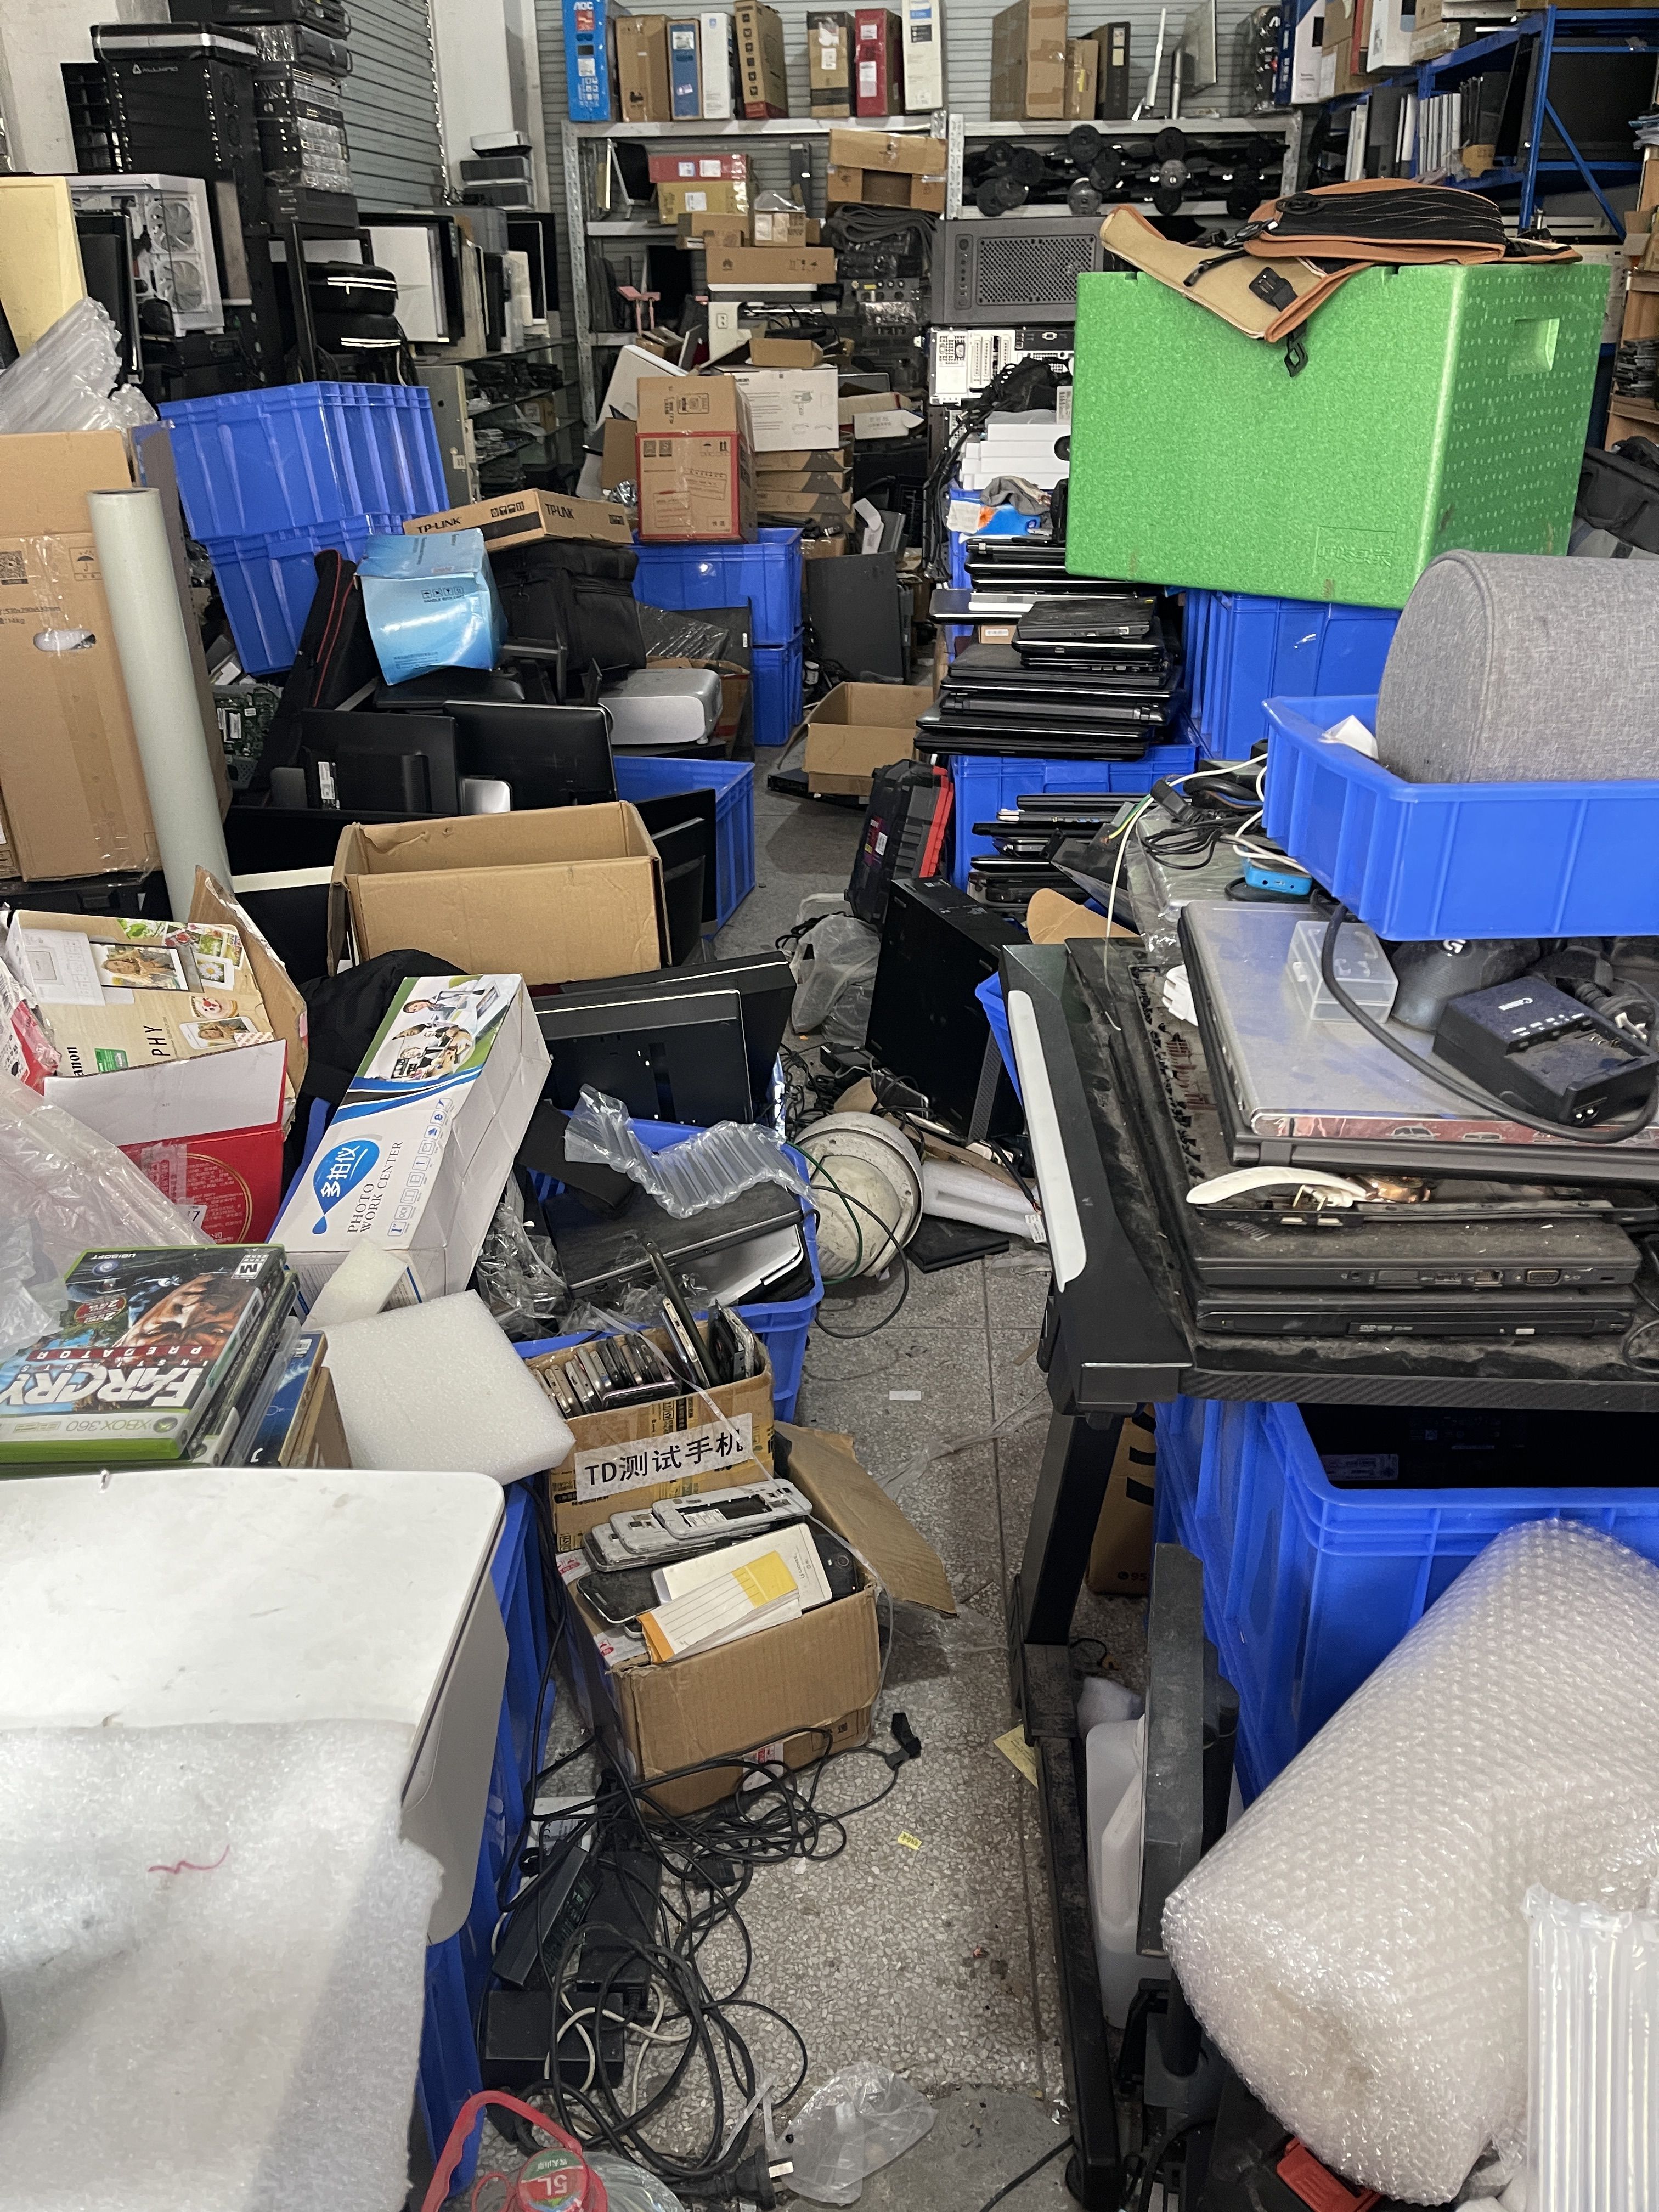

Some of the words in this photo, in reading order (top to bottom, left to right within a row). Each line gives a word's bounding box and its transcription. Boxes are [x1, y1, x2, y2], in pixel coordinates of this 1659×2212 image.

[544, 503, 575, 520] TP-LINK
[416, 516, 462, 533] TP-LINK
[143, 1025, 171, 1057] PHY
[66, 1046, 84, 1076] anon
[320, 1144, 360, 1198] 多拍仪
[360, 1192, 383, 1233] WORK
[377, 1141, 404, 1189] CENTER
[348, 1183, 375, 1233] PHOTO
[90, 1252, 137, 1261] UBISOFT
[239, 1263, 258, 1274] M
[35, 1346, 202, 1360] PREDATOR
[20, 1360, 208, 1372] INSTINCTS
[66, 1420, 99, 1433] 360
[100, 1419, 153, 1432] XBOX
[585, 1429, 744, 1486] TD测试手机
[537, 2175, 567, 2196] 5L
